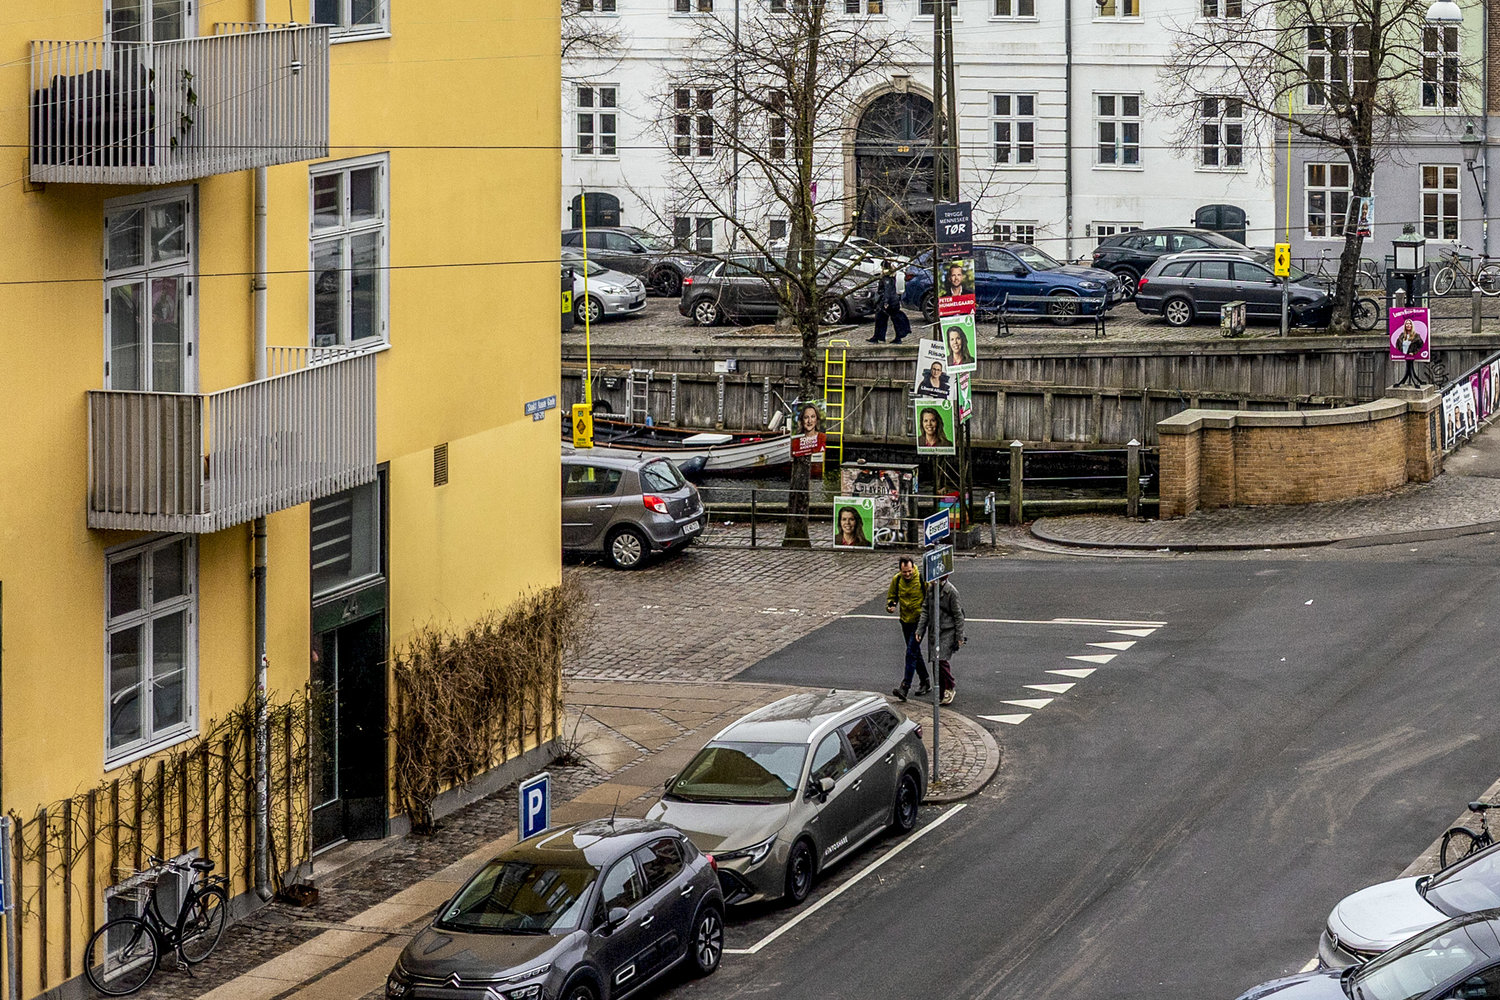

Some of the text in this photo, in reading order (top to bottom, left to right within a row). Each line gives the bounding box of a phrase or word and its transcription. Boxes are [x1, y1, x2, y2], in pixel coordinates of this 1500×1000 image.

[944, 223, 967, 235] TØR
[939, 300, 974, 309] HUMMELGAARD
[930, 342, 945, 350] Mere
[929, 518, 948, 536] Ensrettet
[528, 787, 543, 832] P
